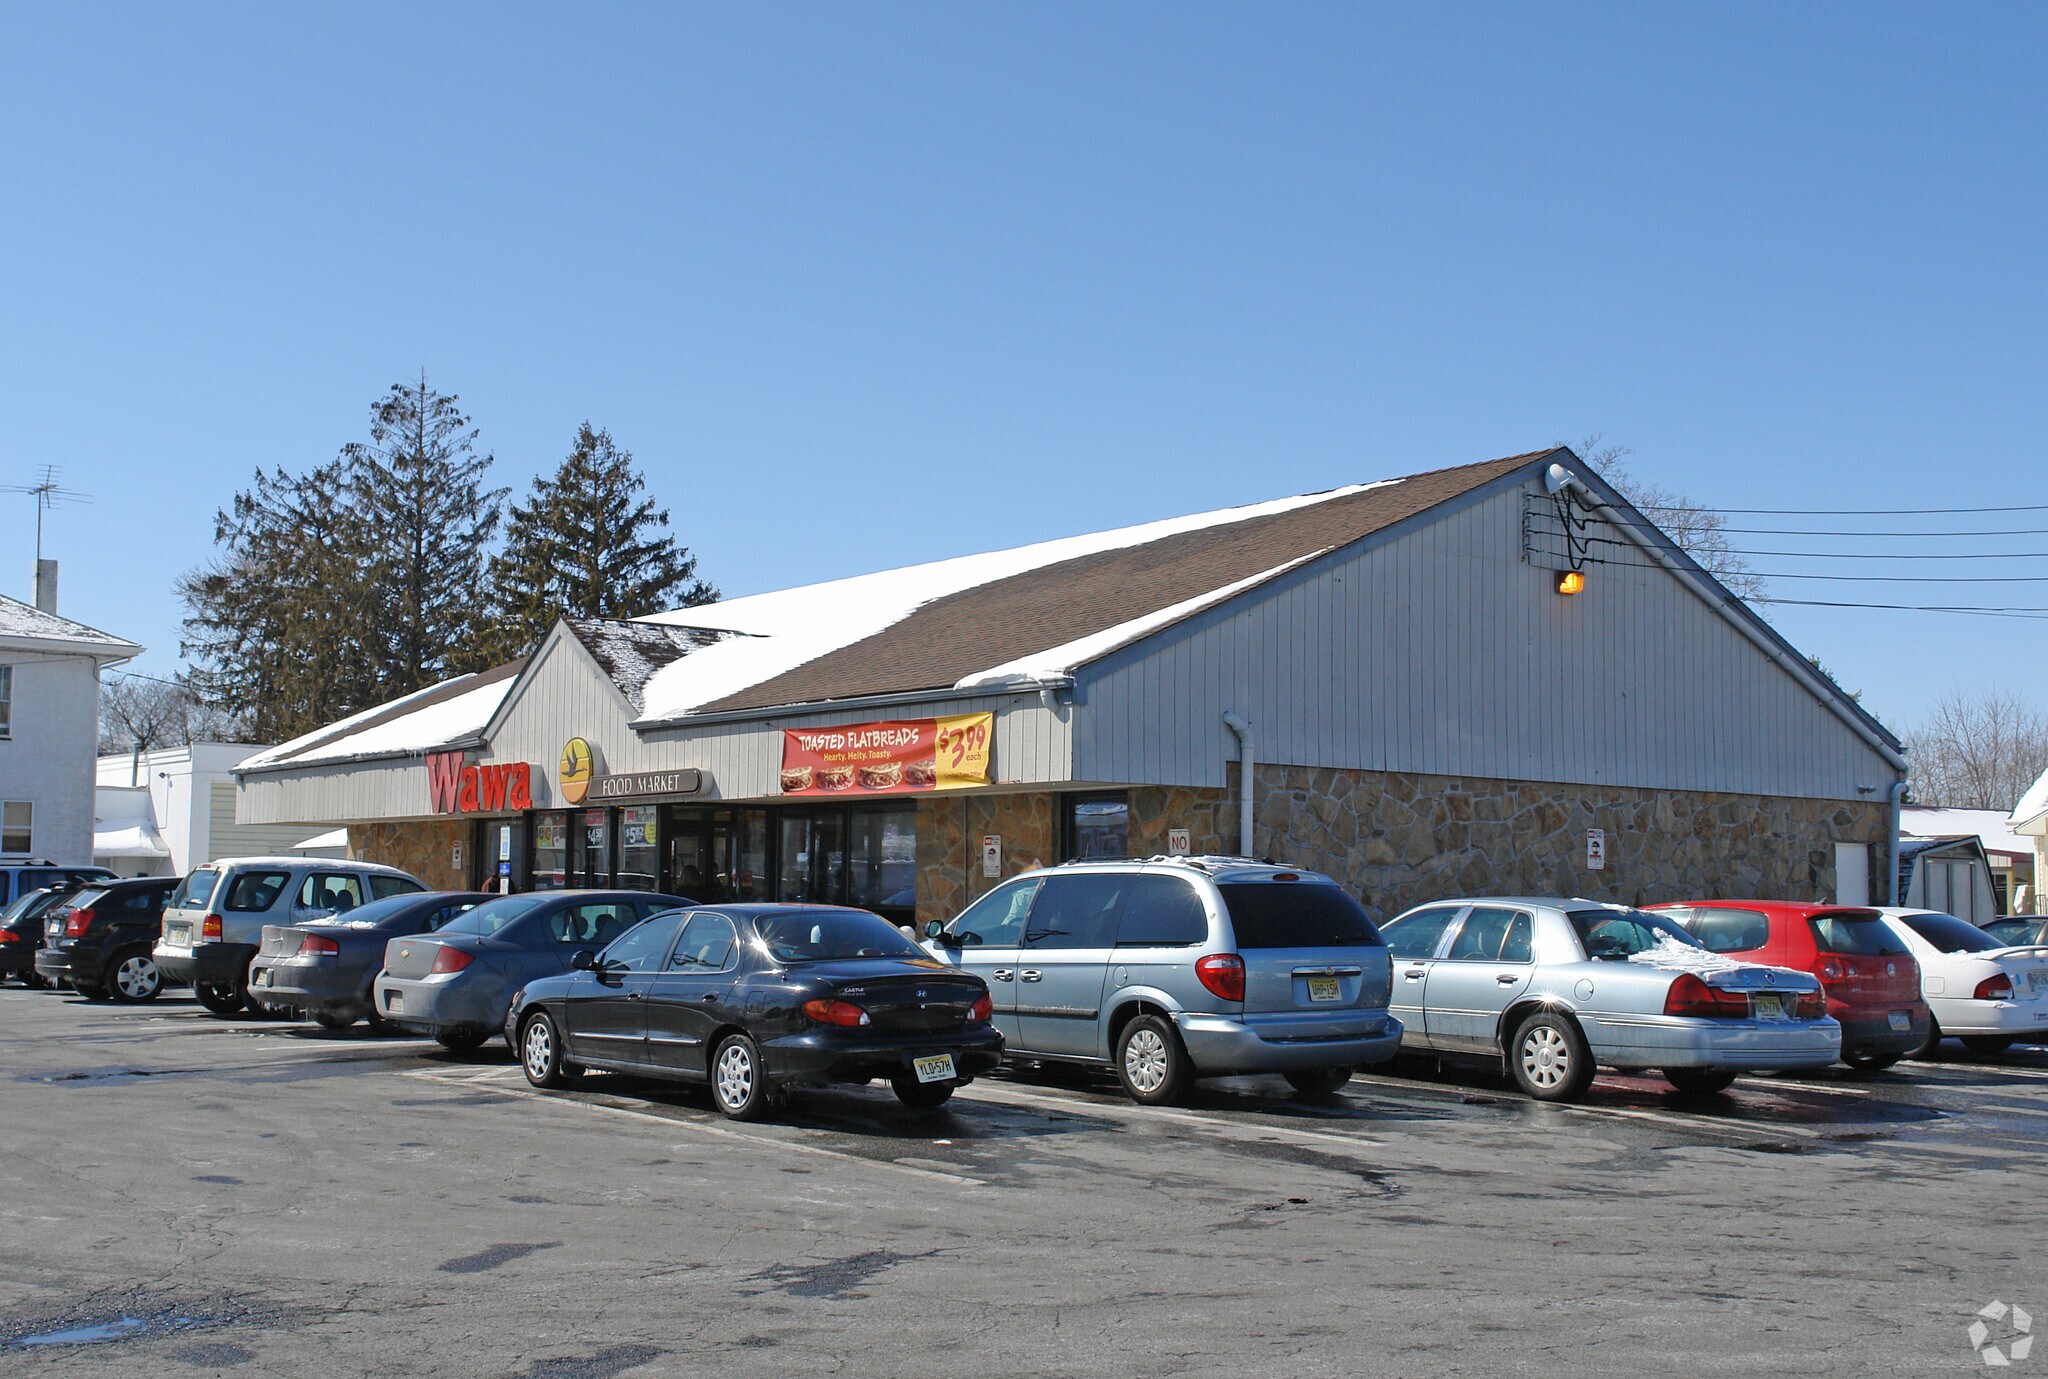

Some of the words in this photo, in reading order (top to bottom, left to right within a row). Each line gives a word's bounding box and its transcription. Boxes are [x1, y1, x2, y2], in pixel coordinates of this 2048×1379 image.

[799, 733, 845, 751] TOASTED
[847, 728, 919, 749] FLATBREADS
[823, 752, 846, 762] Hearty.
[847, 750, 867, 760] Melty.
[868, 749, 892, 759] Toasty.
[966, 752, 981, 761] each
[426, 752, 532, 813] Wawa
[602, 777, 632, 796] FOOD
[637, 774, 680, 793] MARKET
[1171, 836, 1187, 850] NO
